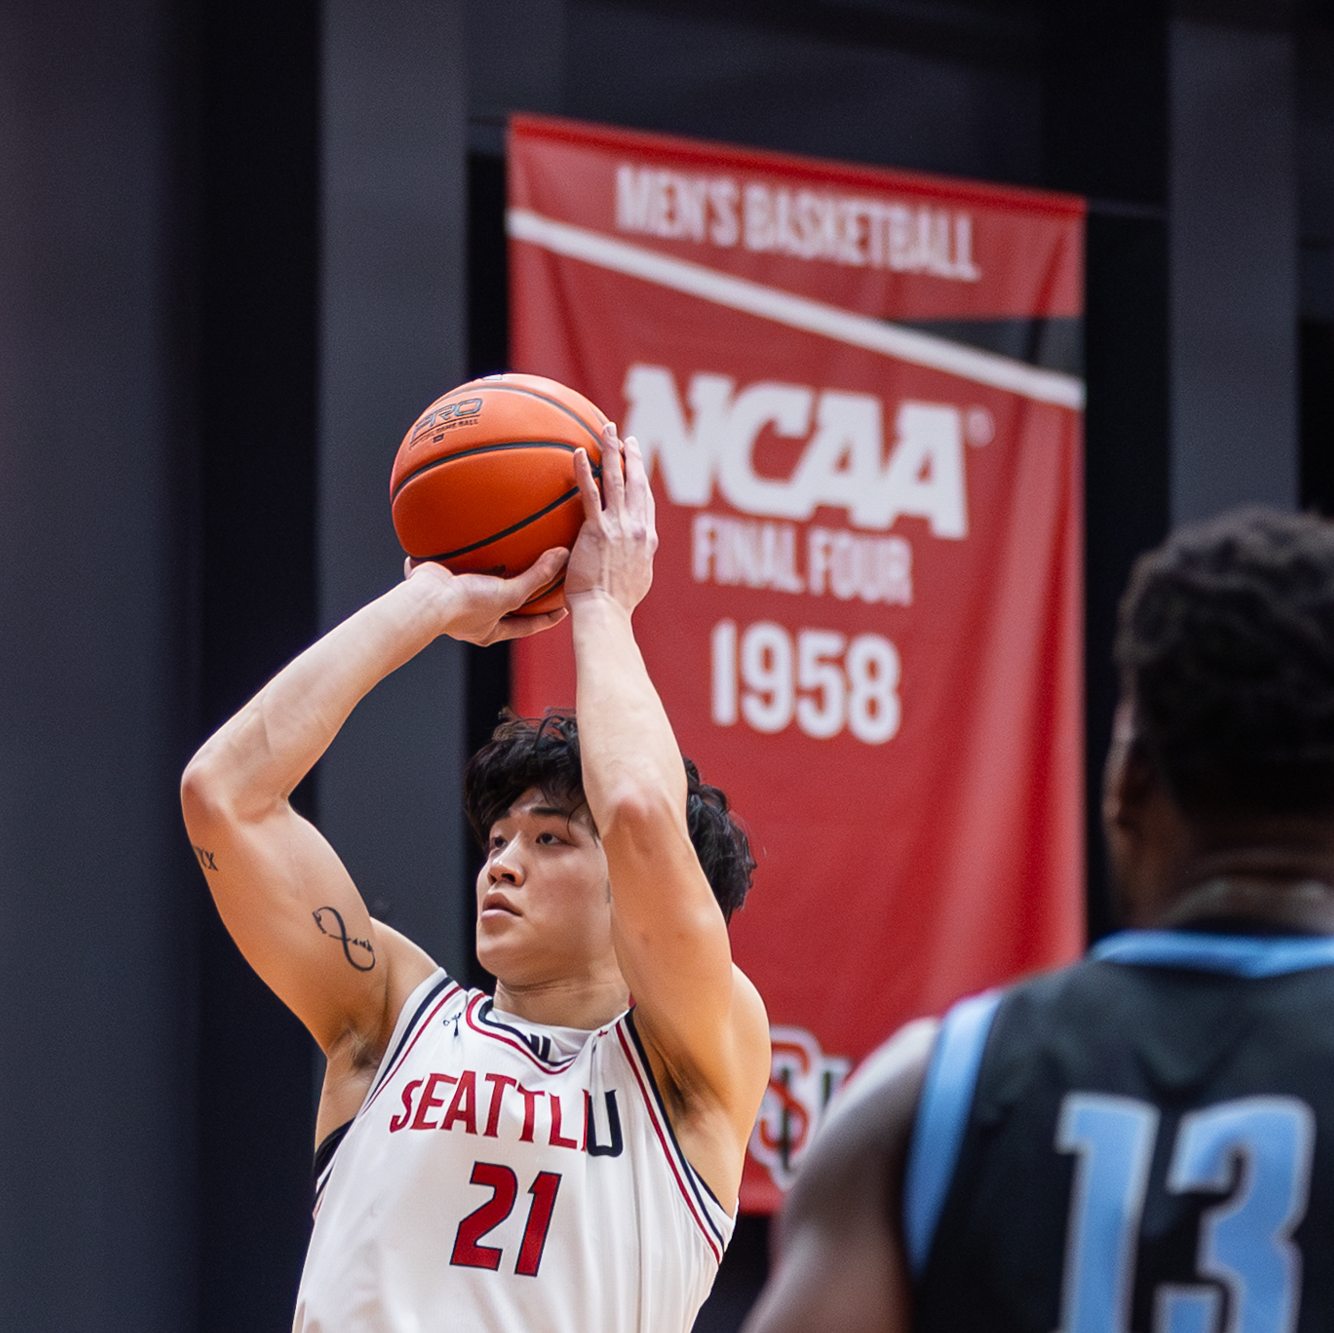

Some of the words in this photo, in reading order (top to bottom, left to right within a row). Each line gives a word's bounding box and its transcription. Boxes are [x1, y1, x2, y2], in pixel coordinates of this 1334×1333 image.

[617, 164, 740, 247] MEN'S
[742, 181, 980, 282] BASKETBALL
[691, 512, 805, 594] FINAL
[807, 526, 913, 606] FOUR
[711, 620, 901, 745] 1958
[450, 1161, 562, 1277] 21
